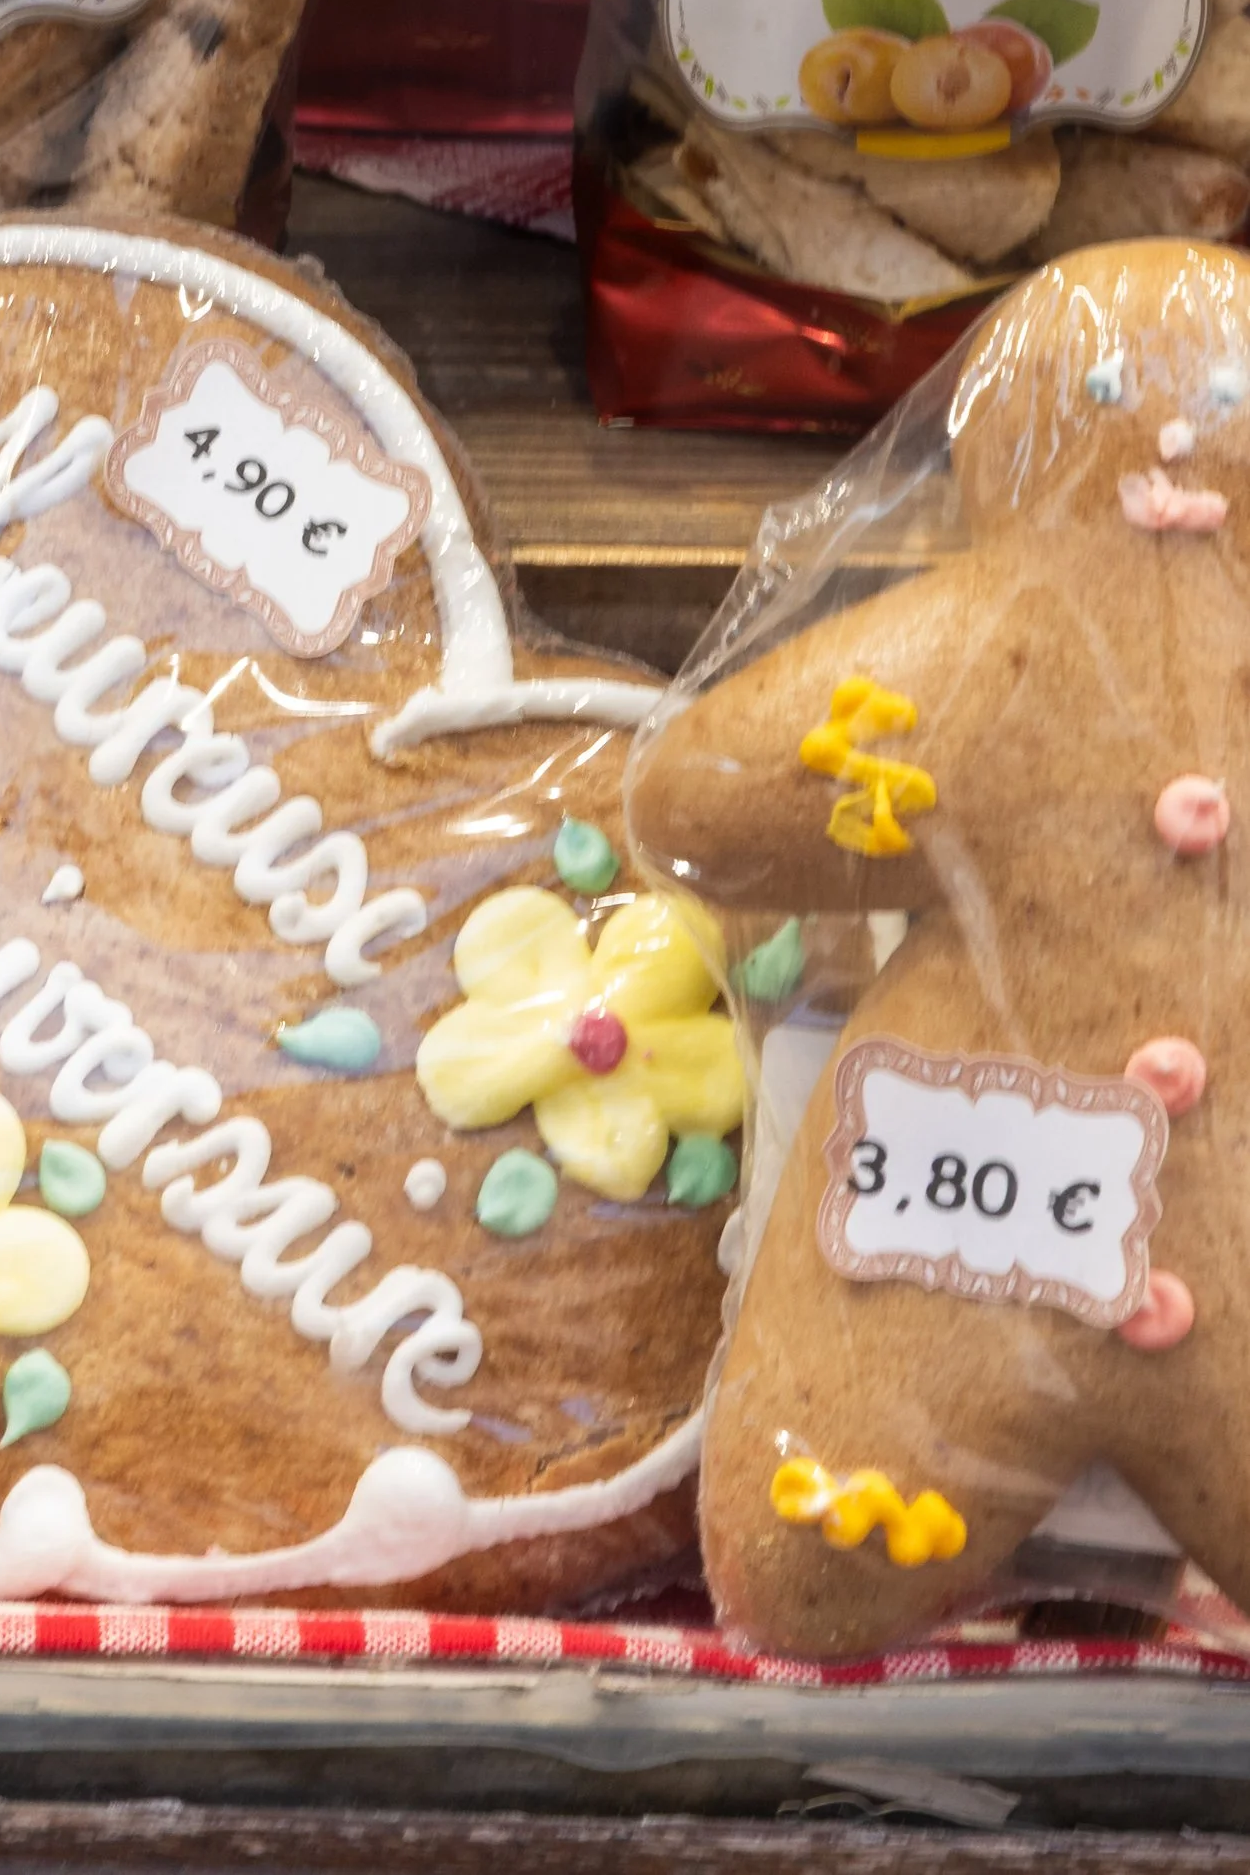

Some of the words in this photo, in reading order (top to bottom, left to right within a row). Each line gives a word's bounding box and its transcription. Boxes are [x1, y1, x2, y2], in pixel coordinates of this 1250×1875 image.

[184, 425, 296, 521] 4,90
[301, 516, 348, 558] €
[848, 1140, 1018, 1219] 3,80
[1048, 1181, 1100, 1235] €
